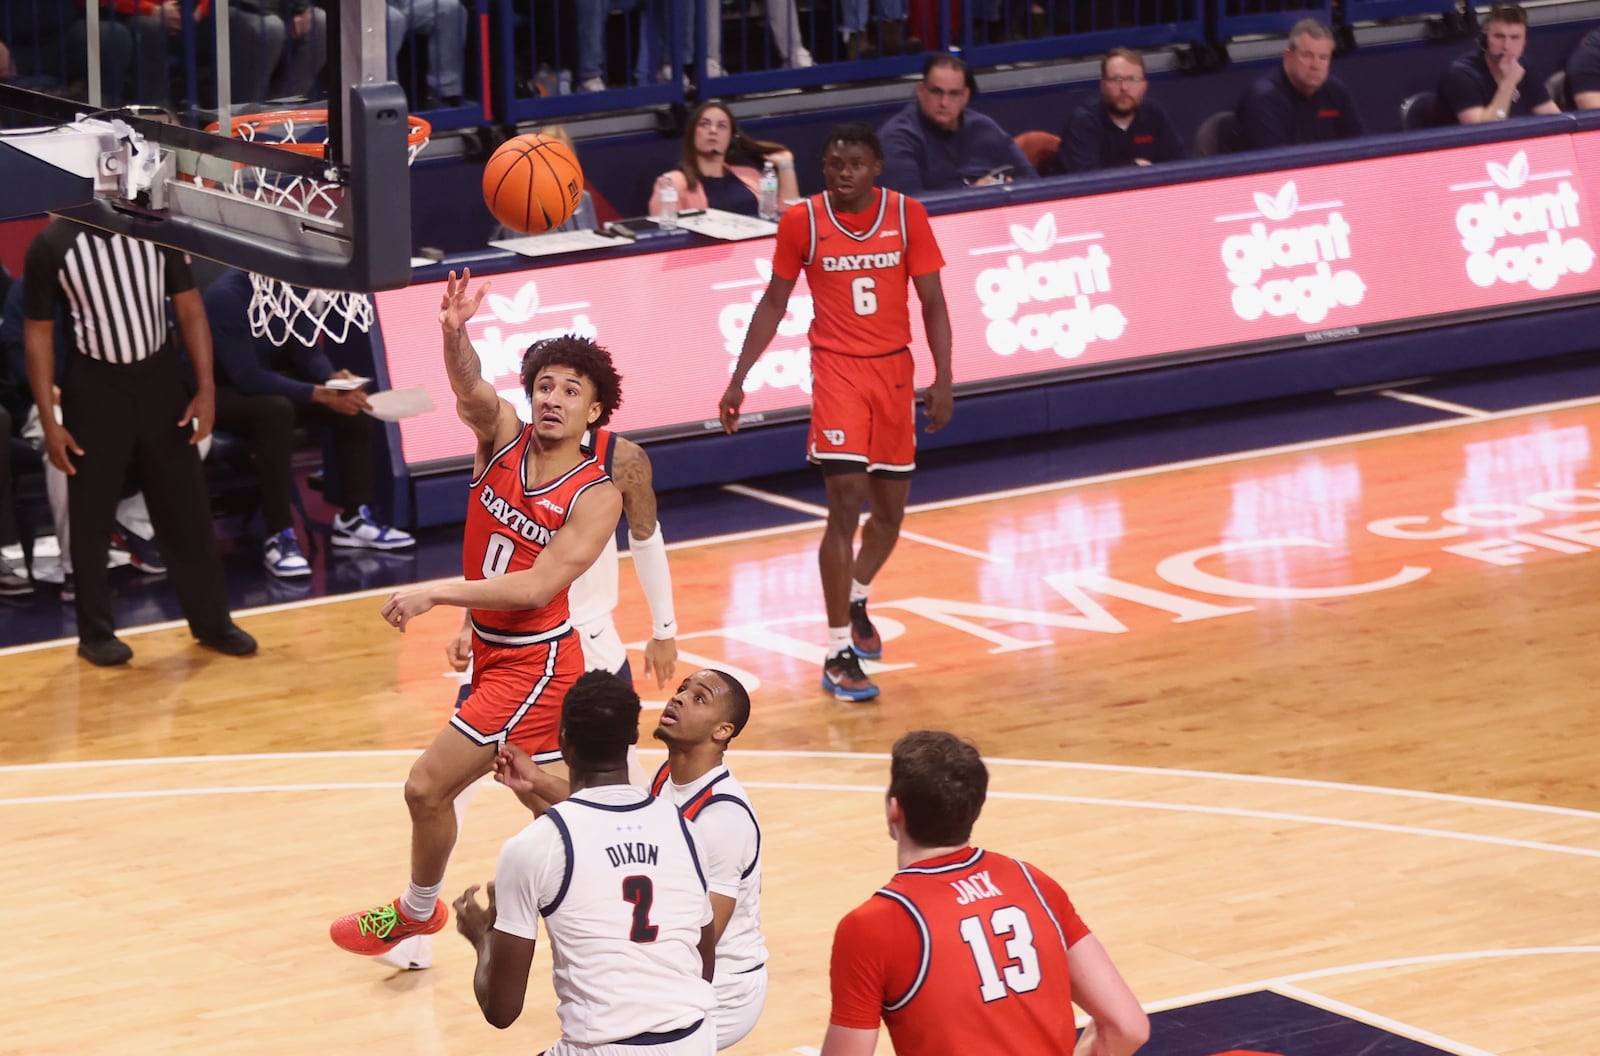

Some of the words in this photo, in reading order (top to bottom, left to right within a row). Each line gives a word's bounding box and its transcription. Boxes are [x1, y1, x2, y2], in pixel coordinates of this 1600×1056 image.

[1220, 212, 1352, 286] giant
[1455, 181, 1580, 254] giant
[821, 250, 902, 272] DAYTON
[975, 243, 1112, 322] giant
[851, 275, 879, 317] 6
[479, 483, 558, 547] DAYTON
[482, 531, 516, 580] 0
[605, 841, 659, 868] DIXON
[622, 874, 660, 945] 2
[949, 870, 1003, 905] JACK
[959, 904, 1042, 1004] 13
